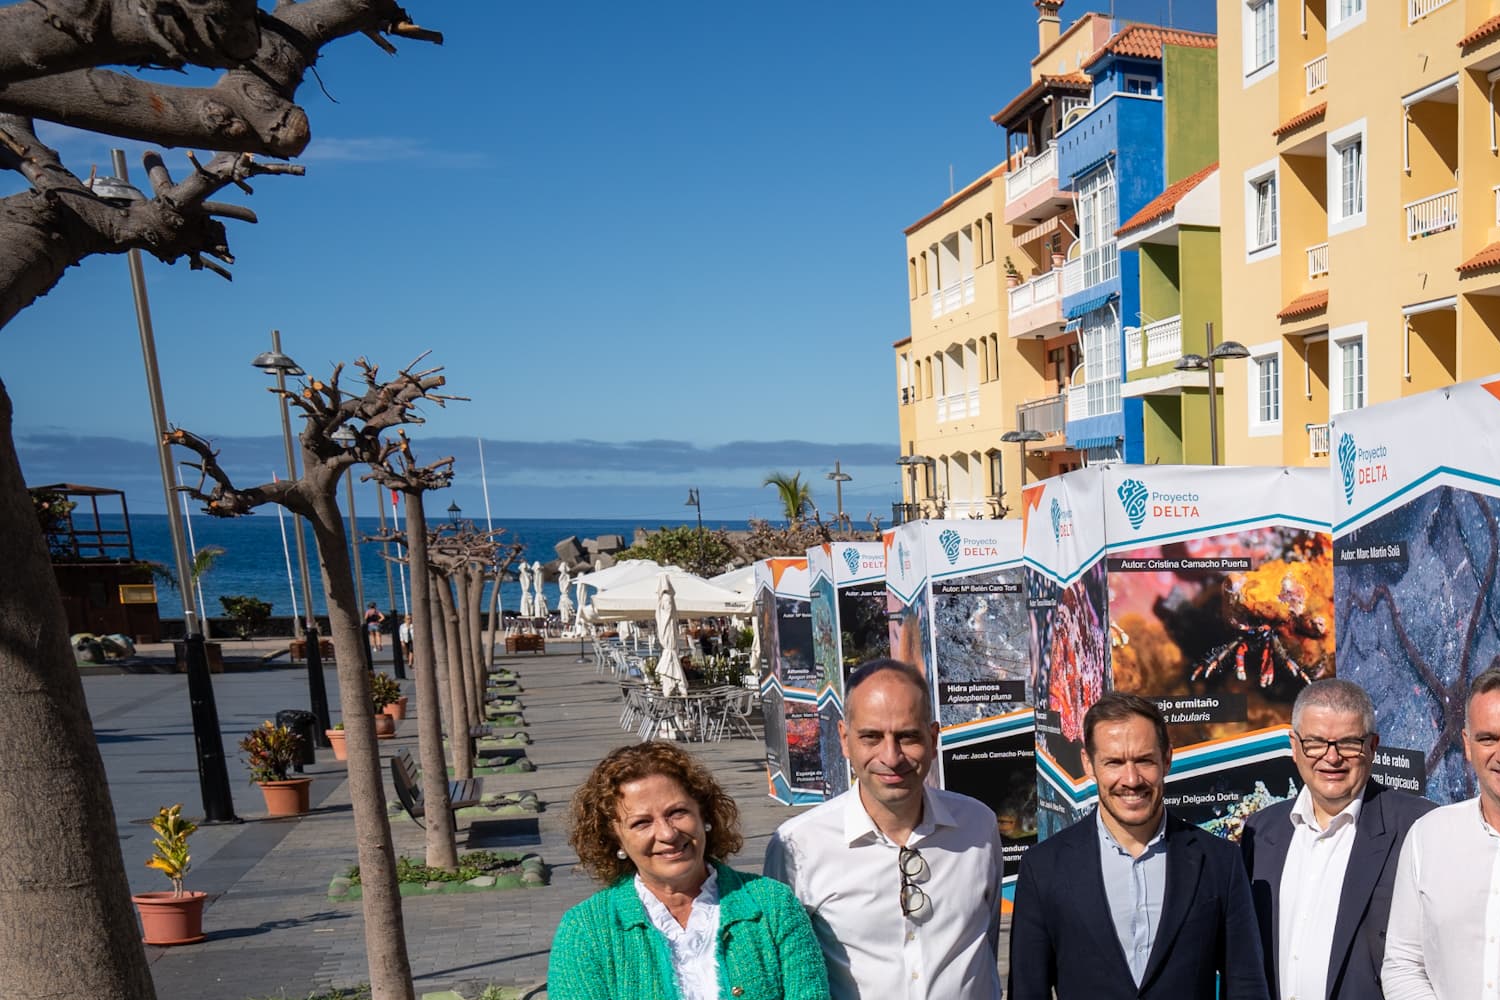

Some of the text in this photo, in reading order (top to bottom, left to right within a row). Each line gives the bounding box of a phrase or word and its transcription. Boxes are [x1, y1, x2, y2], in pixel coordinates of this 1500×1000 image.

[1358, 446, 1387, 463] Proyecto
[1358, 465, 1388, 485] DELTA
[1152, 491, 1199, 504] Proyecto
[1153, 506, 1199, 518] DELTA
[963, 538, 998, 546] Proyecto
[964, 548, 998, 556] DELTA
[1340, 549, 1357, 560] Autor:
[1357, 548, 1370, 559] Marc
[1121, 559, 1248, 569] Autor: Cristina Camacho Puerta
[969, 684, 1000, 693] plumosa
[991, 693, 1012, 702] pluma
[1175, 698, 1219, 709] ermitaño
[1171, 713, 1211, 723] tubularis
[1382, 753, 1391, 766] de
[1391, 754, 1410, 769] ratón
[1384, 773, 1419, 790] longicauda
[1163, 793, 1239, 805] eray Delgado Dorta
